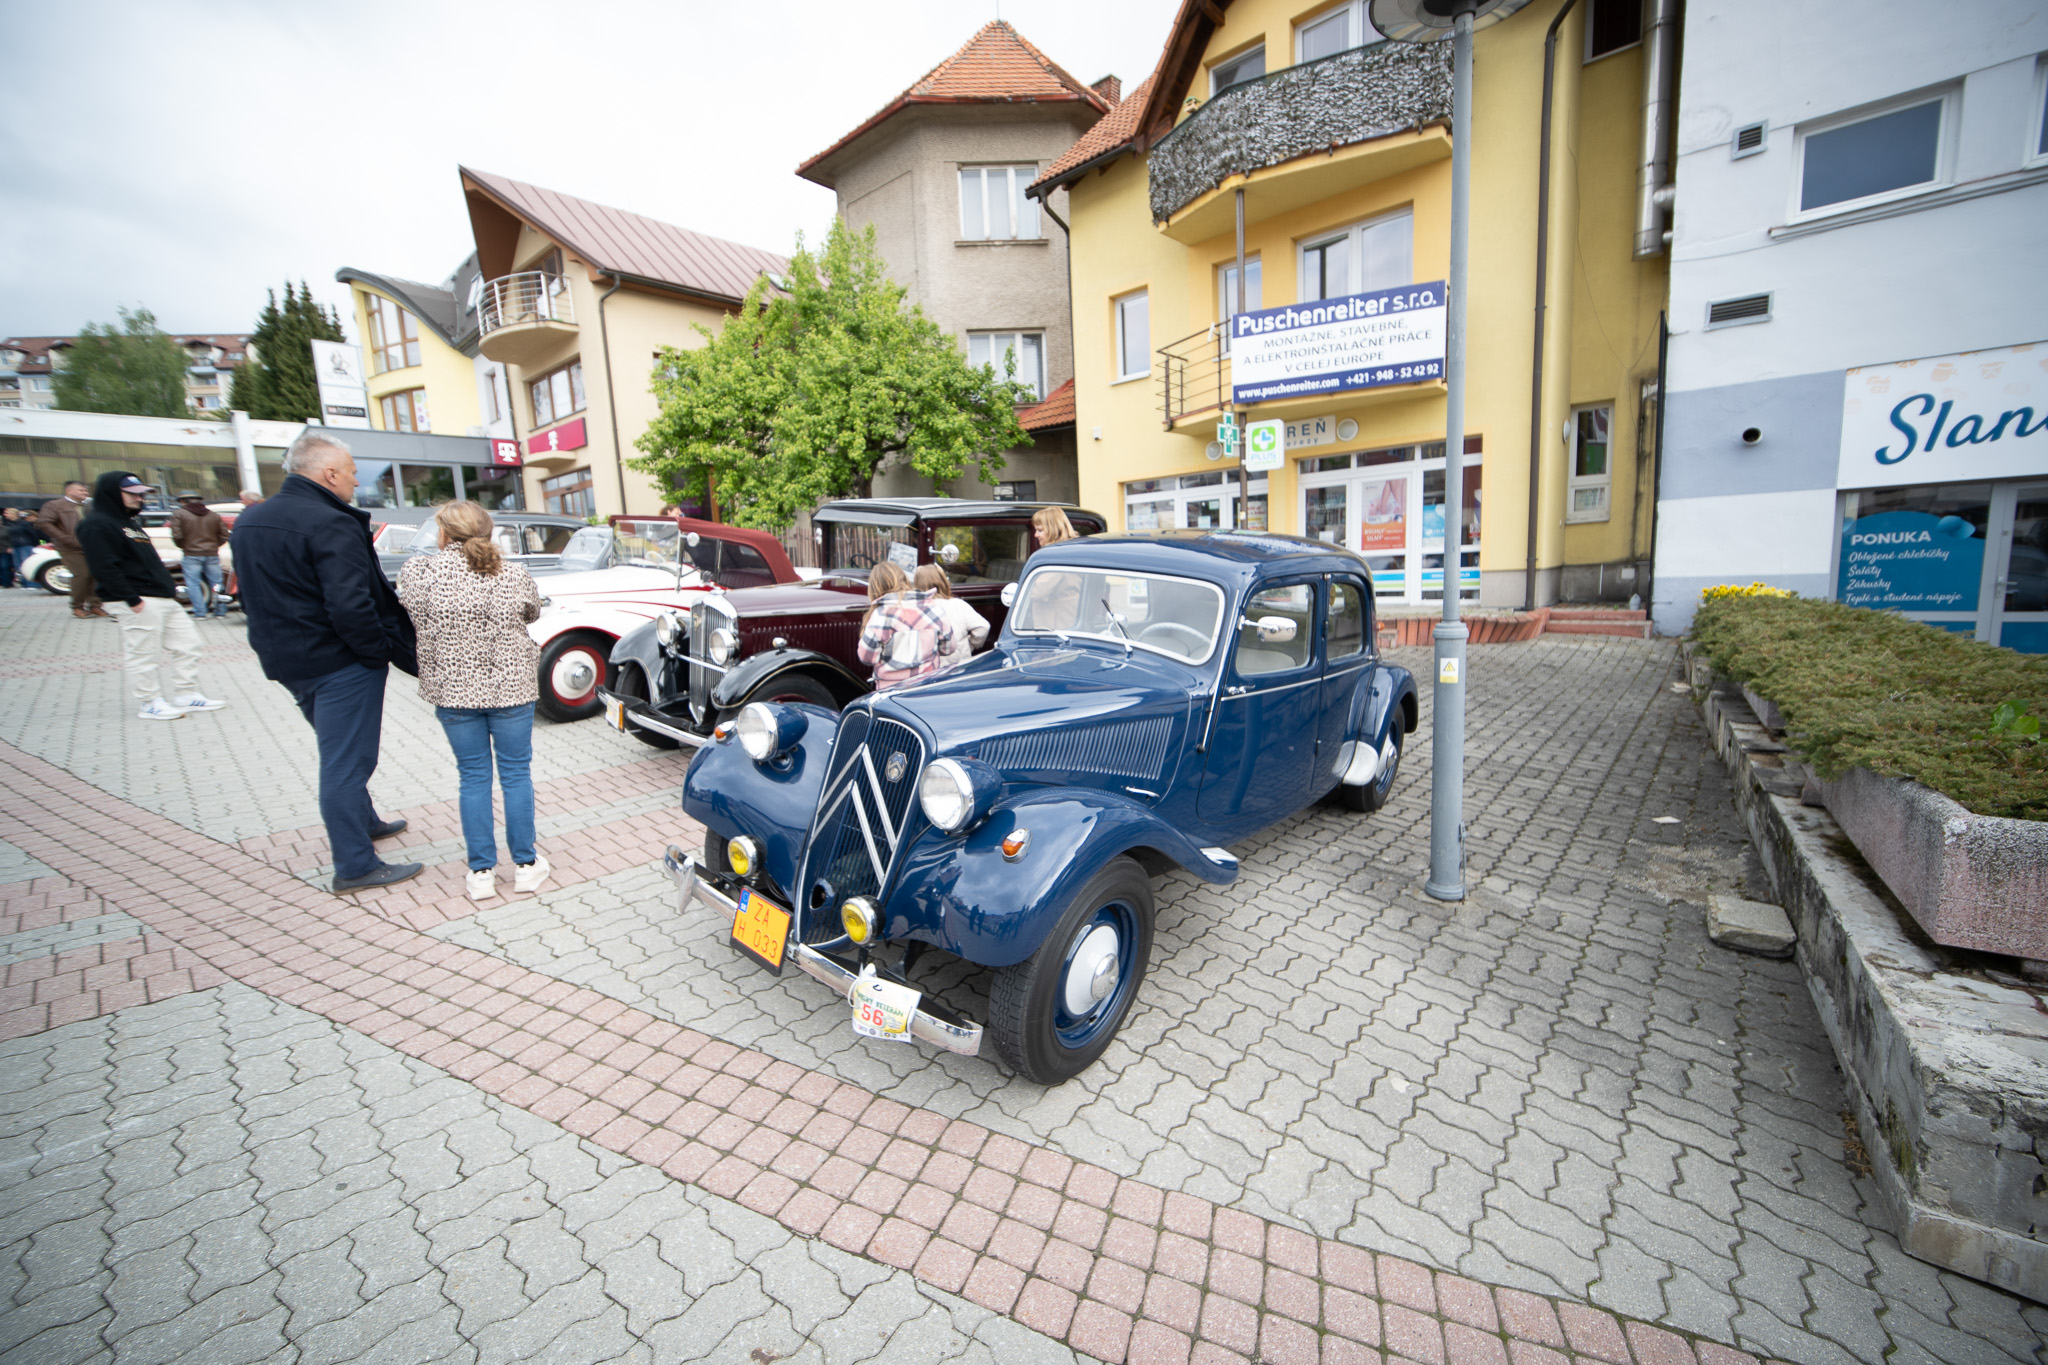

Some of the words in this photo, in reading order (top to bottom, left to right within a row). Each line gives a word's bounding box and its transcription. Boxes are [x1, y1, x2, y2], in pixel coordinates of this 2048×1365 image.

[1238, 296, 1389, 336] Puschenreiter
[1392, 290, 1437, 311] s.r.o.
[1243, 356, 1252, 365] A
[1285, 363, 1293, 373] V
[1296, 358, 1331, 371] CELEJ
[1238, 377, 1340, 399] www.puschenreiter.com
[1345, 372, 1370, 385] +421
[1376, 369, 1394, 382] 948
[1400, 366, 1412, 379] 52
[1413, 365, 1426, 376] 42
[1426, 363, 1439, 375] 92
[1875, 393, 2048, 466] Slan
[1851, 531, 1931, 545] PONUKA
[1849, 550, 1896, 564] Obložené
[1846, 578, 1892, 591] Zákusky
[1846, 592, 1871, 605] Teplé
[1883, 592, 1924, 602] studené
[1926, 592, 1963, 604] nápoje
[754, 902, 770, 928] ZA
[753, 929, 778, 958] 033
[861, 1003, 884, 1026] 56
